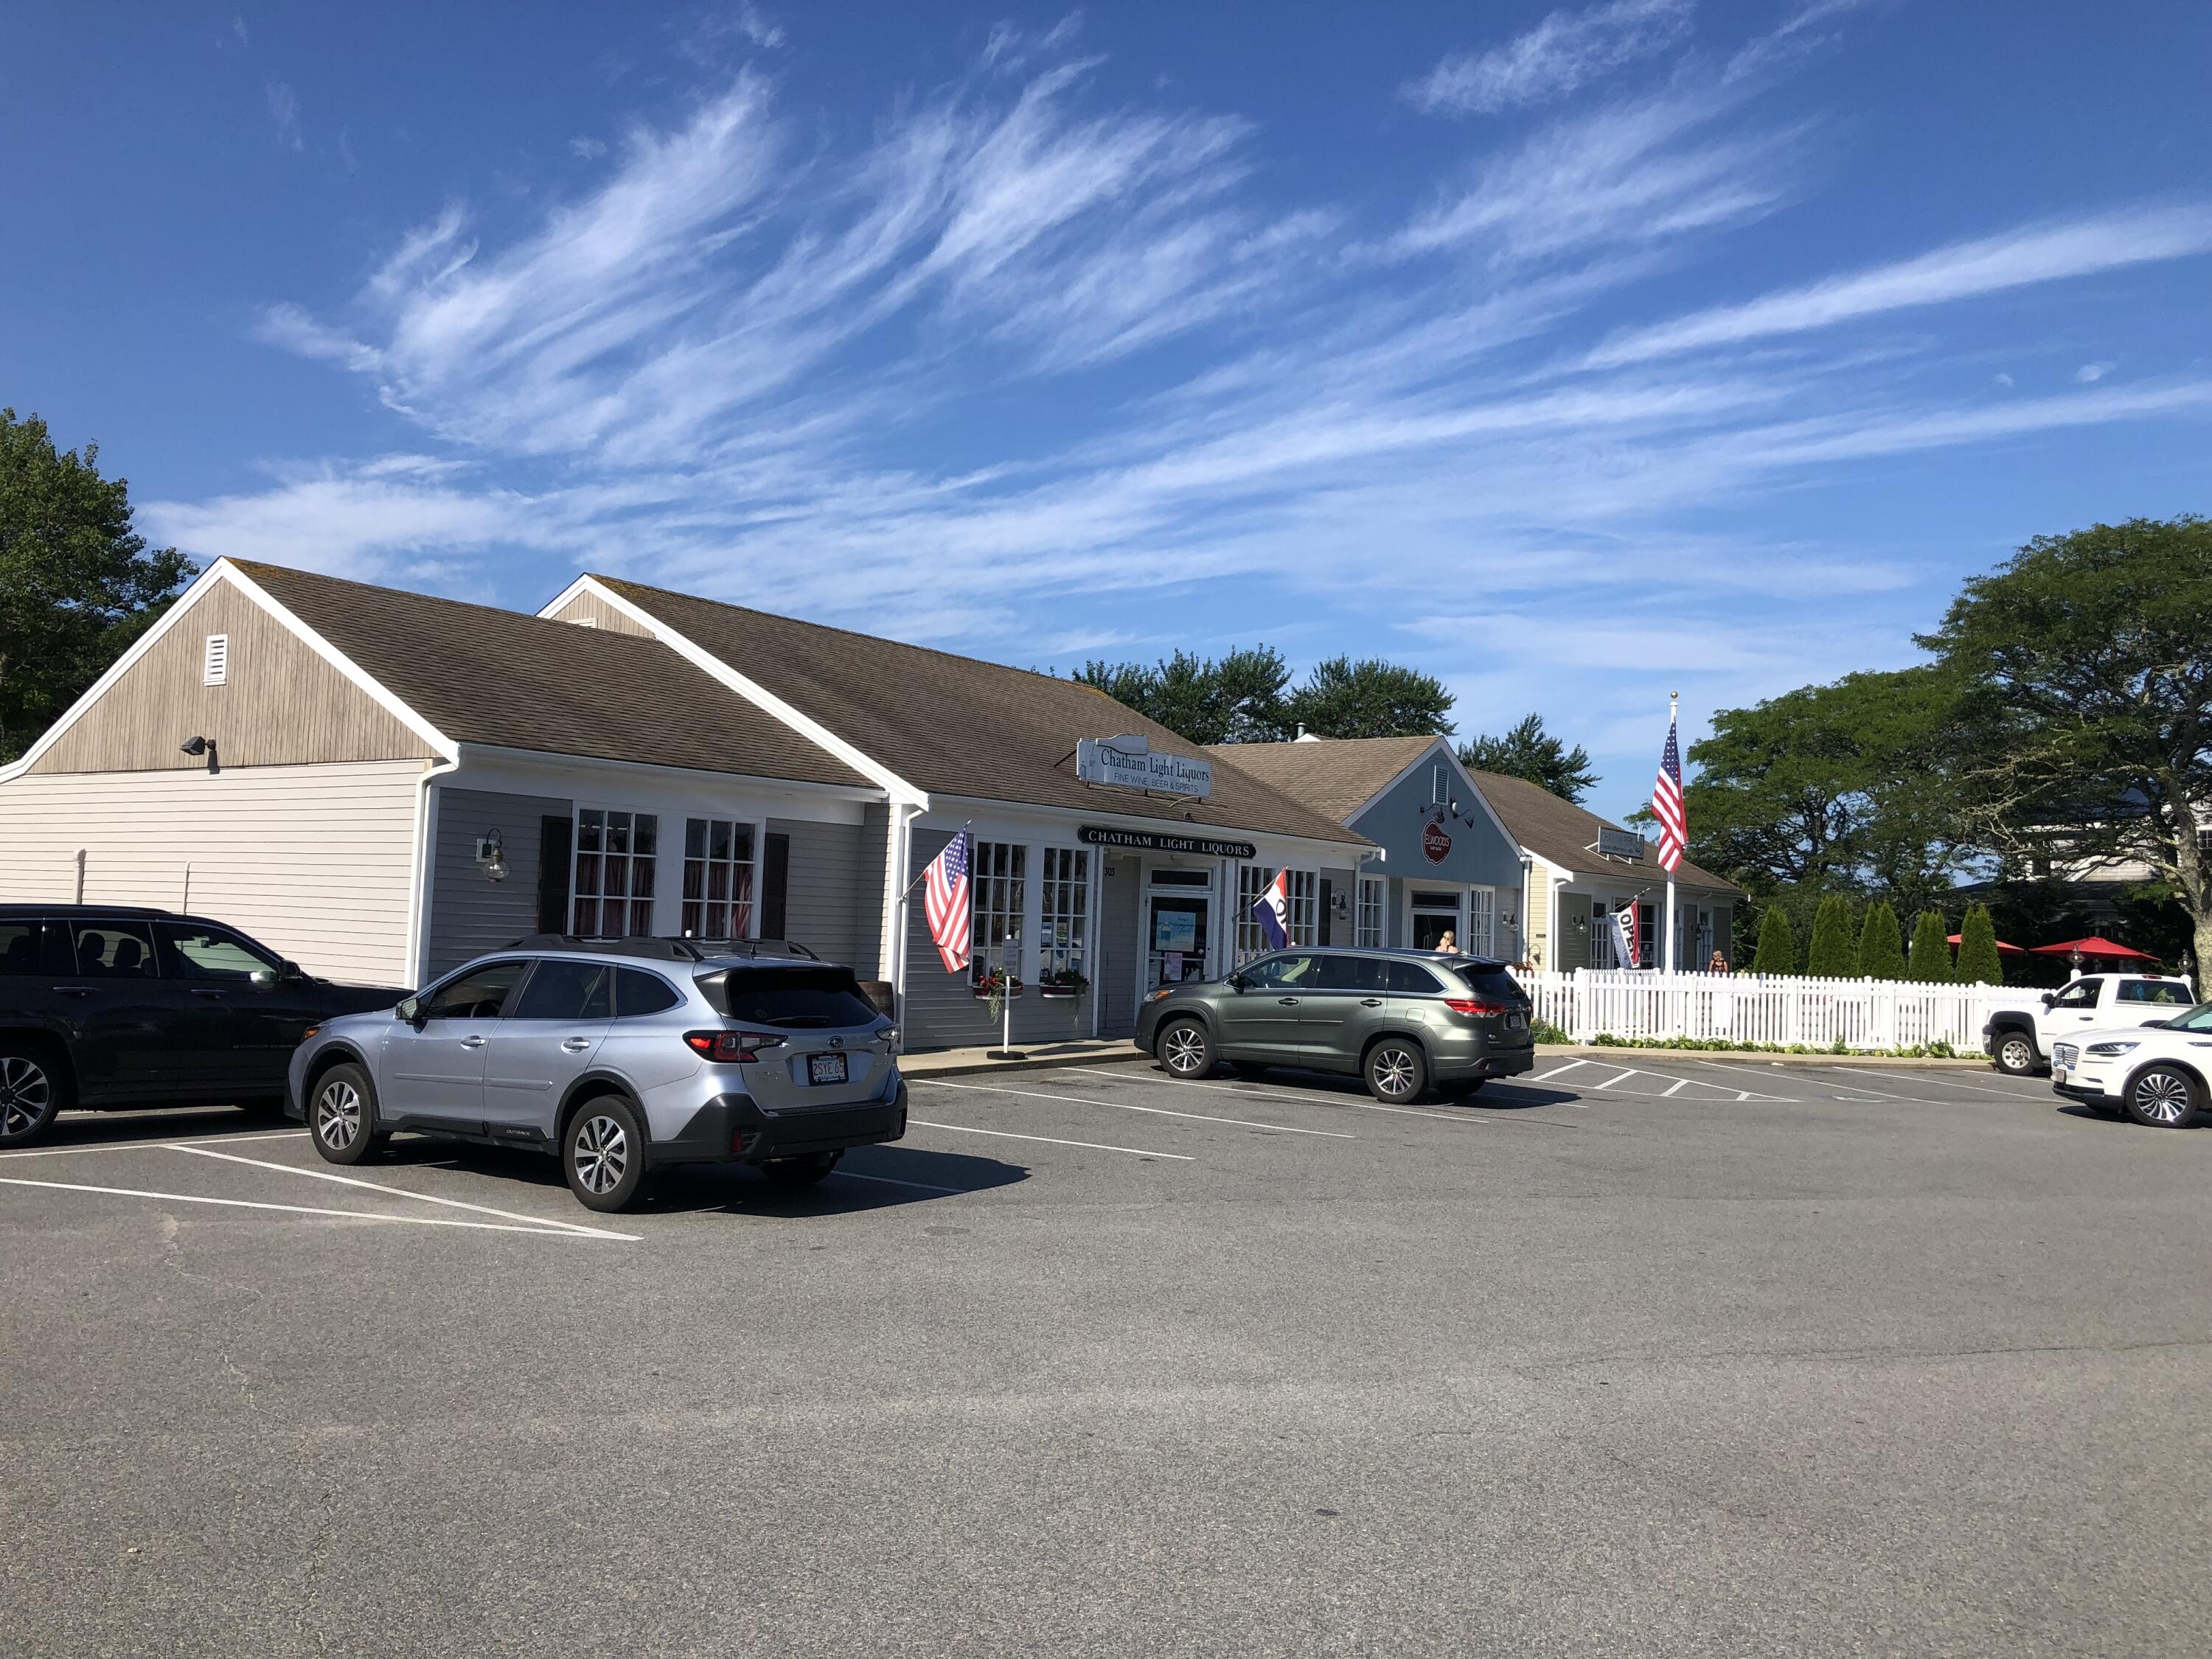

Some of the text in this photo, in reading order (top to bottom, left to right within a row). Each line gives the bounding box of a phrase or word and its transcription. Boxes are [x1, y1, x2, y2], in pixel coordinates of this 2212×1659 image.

[1101, 748, 1209, 782] Chatham Light Liquors
[1114, 773, 1129, 782] FINE
[1151, 778, 1169, 787] BEER
[1169, 782, 1175, 790] &
[1175, 782, 1198, 793] SPIRITS
[1088, 830, 1250, 856] CHATHAM LIGHT LIQUORS
[1104, 866, 1116, 877] 303
